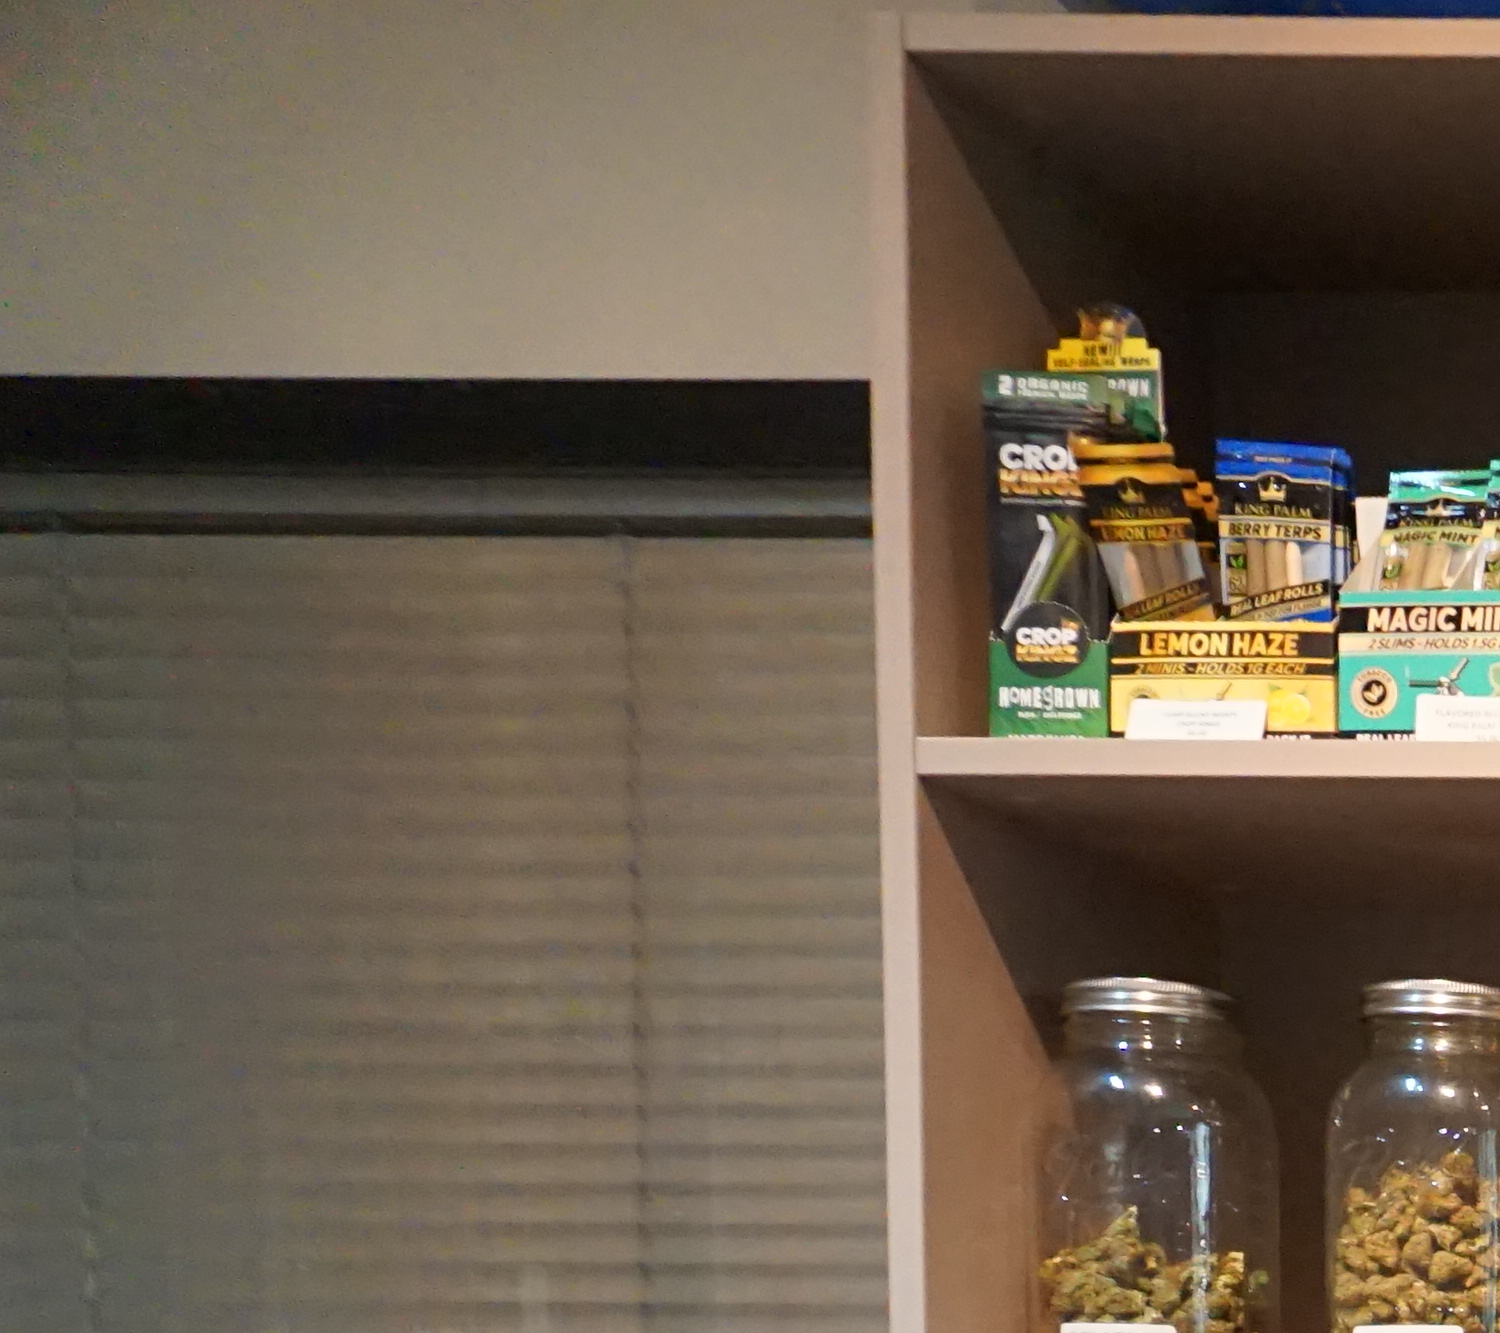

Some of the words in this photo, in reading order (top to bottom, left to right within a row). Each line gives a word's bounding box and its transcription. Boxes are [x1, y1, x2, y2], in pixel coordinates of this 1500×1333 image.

[1235, 503, 1270, 516] KING
[1274, 504, 1314, 518] PALM
[1229, 523, 1271, 539] BERRY
[1275, 523, 1322, 540] TERPS
[1393, 530, 1436, 543] MAGIC
[1440, 531, 1479, 544] MINT
[1280, 582, 1324, 604] ROLLS
[1367, 606, 1456, 633] MAGIC
[1015, 626, 1080, 646] CROP
[1140, 632, 1229, 657] LEMON
[1233, 632, 1299, 656] HAZE
[1369, 639, 1378, 650] 2
[1379, 638, 1416, 650] SLIMS
[1425, 637, 1471, 650] HOLDS
[1196, 662, 1245, 675] HOLDS
[1248, 663, 1265, 675] 1G
[1266, 662, 1308, 675] EACH
[1356, 667, 1393, 684] TOBACCO
[999, 685, 1101, 710] HOMEGROWN
[1363, 708, 1386, 717] FREE
